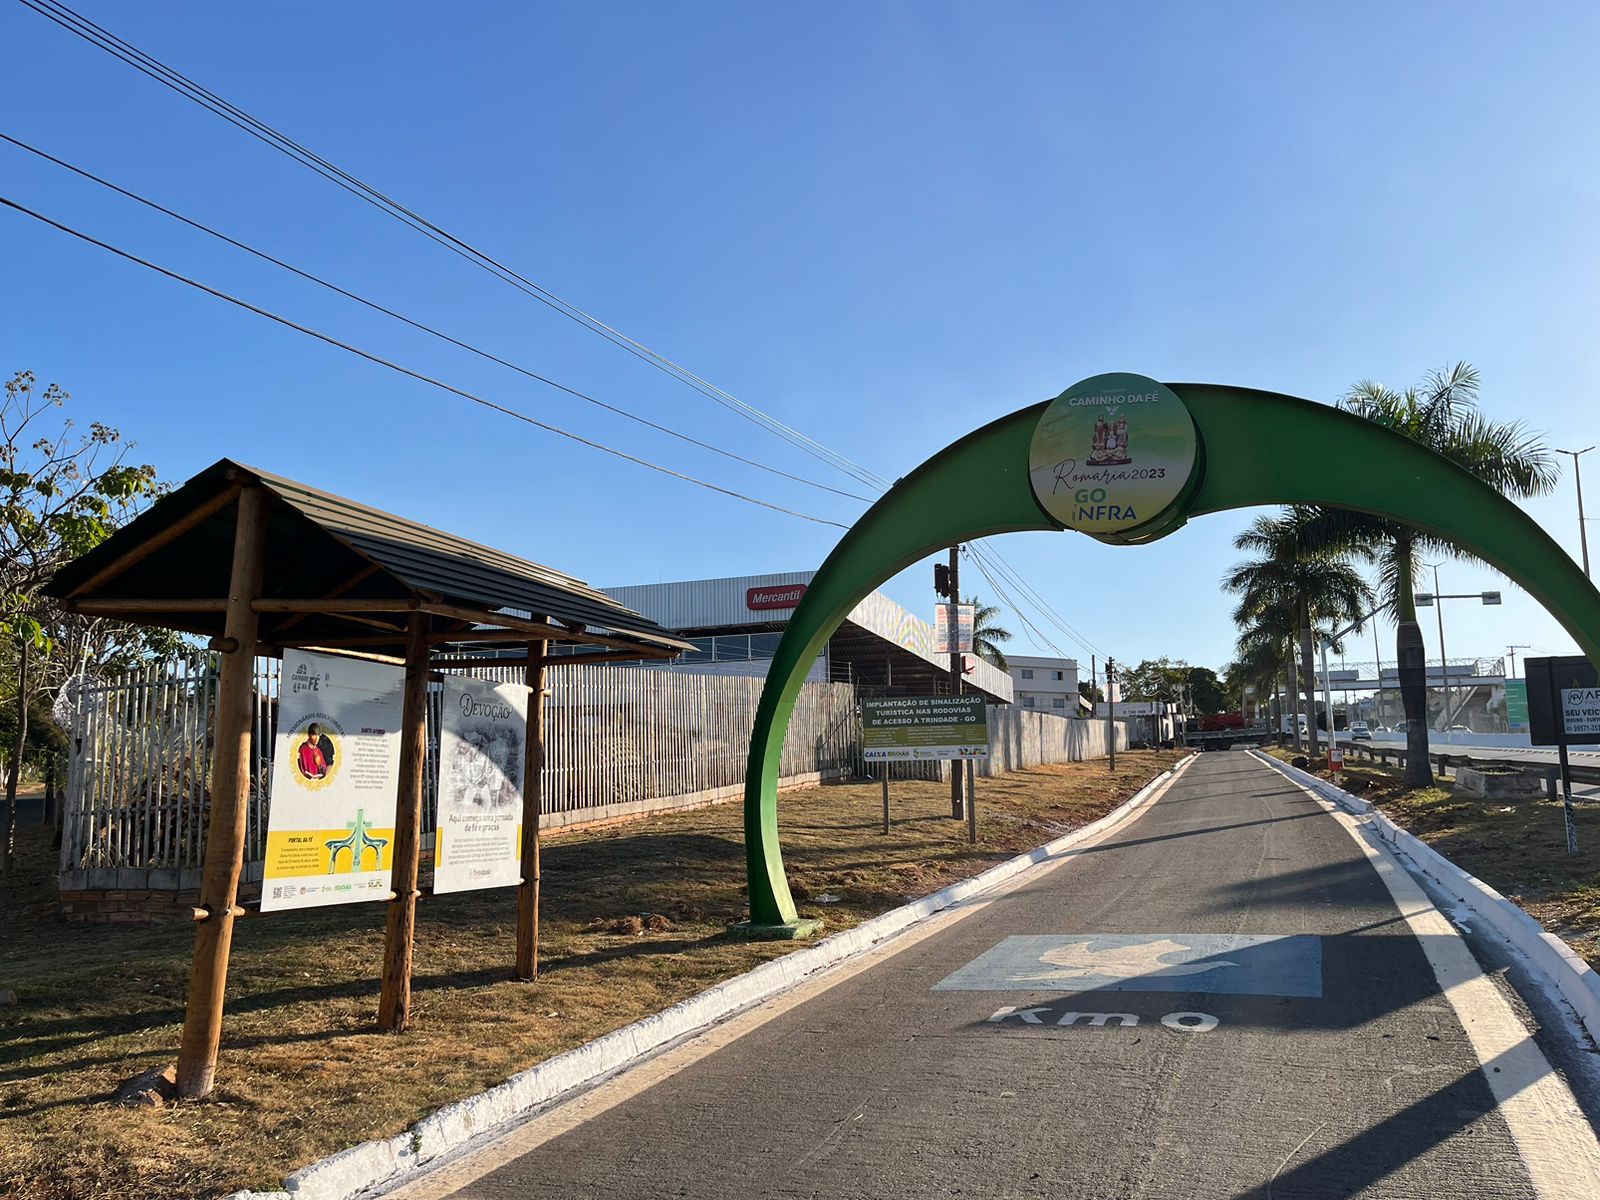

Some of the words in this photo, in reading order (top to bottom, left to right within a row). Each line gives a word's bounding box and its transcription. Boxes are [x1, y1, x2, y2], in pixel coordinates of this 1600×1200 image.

[1069, 394, 1126, 407] CAMINHO
[1128, 394, 1144, 404] DA
[1145, 391, 1160, 402] FÉ
[1053, 458, 1132, 495] Romaria
[1131, 468, 1166, 480] 2023
[1074, 488, 1107, 503] GO
[752, 590, 800, 604] Mercantil
[308, 674, 320, 691] FÉ
[866, 698, 917, 708] IMPLANTAÇÃO
[930, 697, 981, 706] SINALIZAÇÃO
[876, 708, 914, 716] TURÍSTICA
[921, 716, 959, 724] TRINDADE
[449, 814, 461, 824] Aqui
